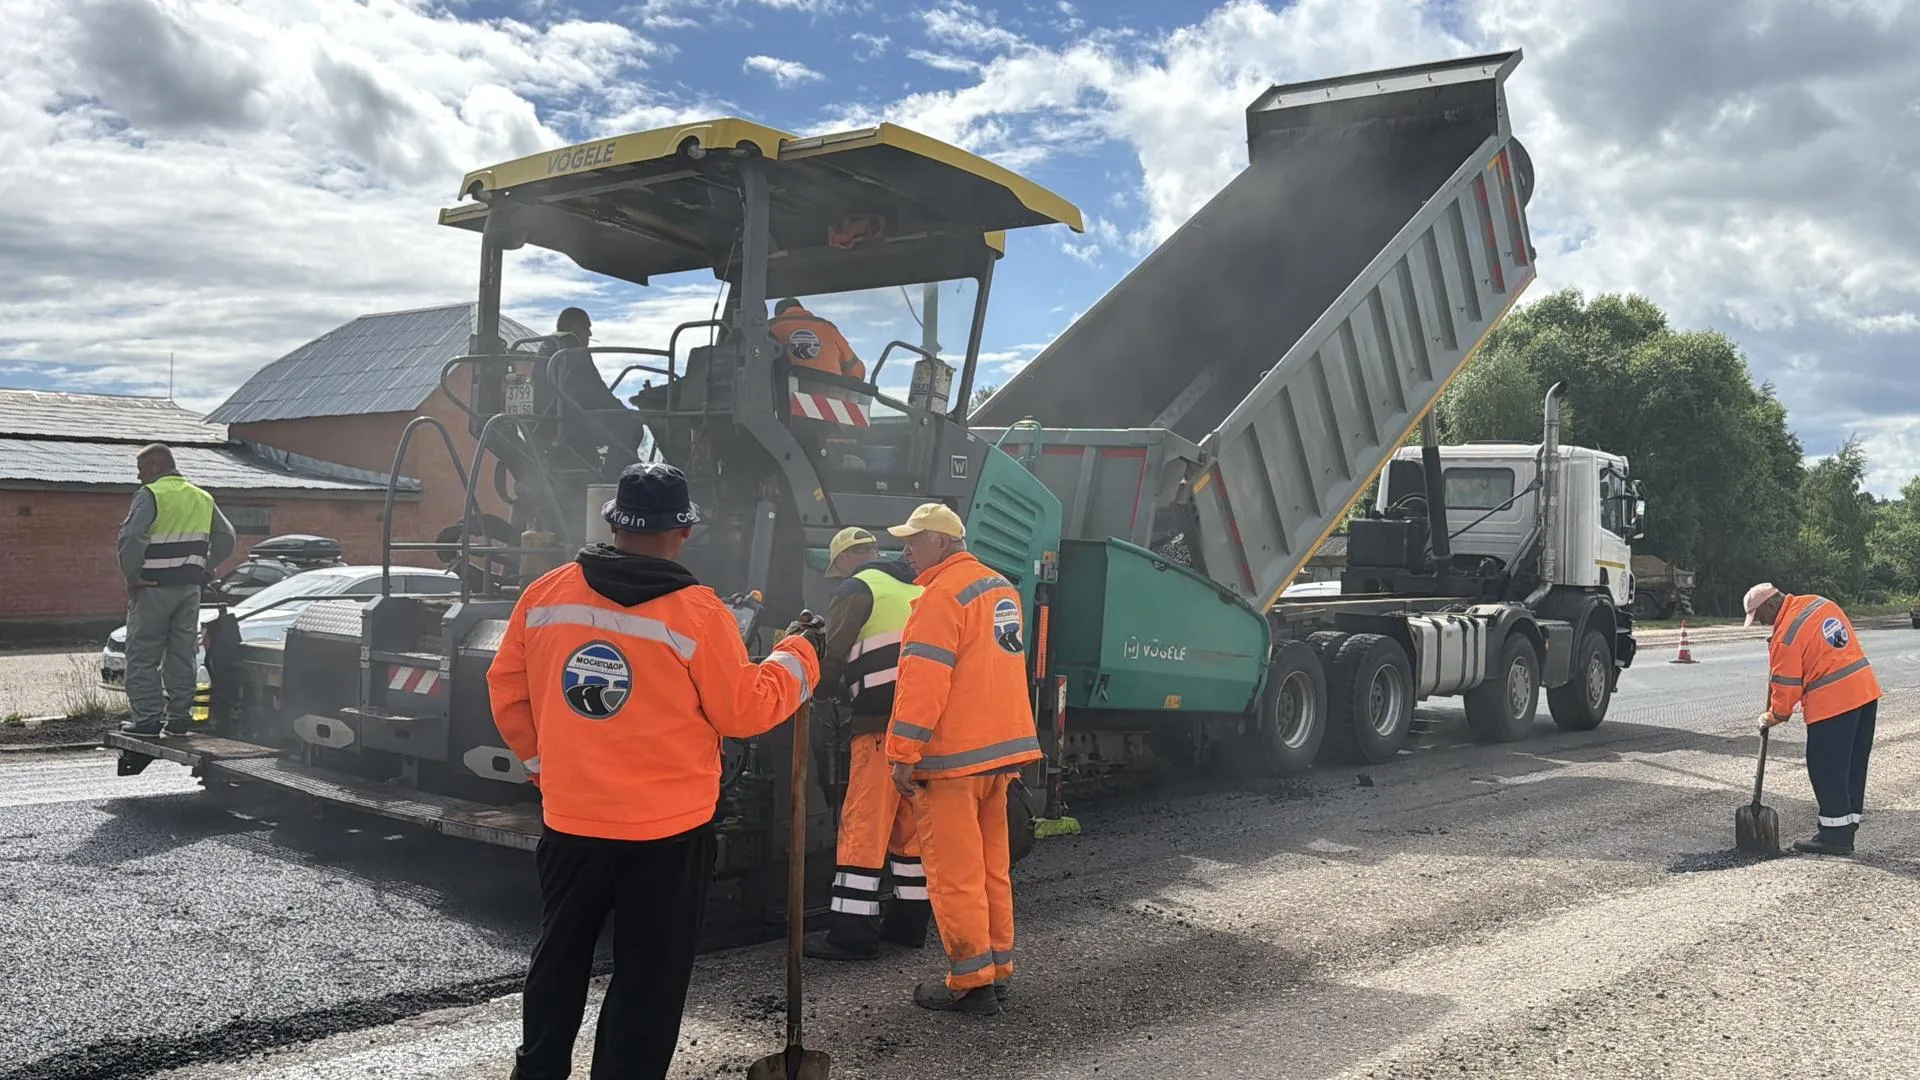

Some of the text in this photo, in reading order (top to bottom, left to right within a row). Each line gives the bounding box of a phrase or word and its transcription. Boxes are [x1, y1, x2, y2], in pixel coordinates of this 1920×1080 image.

[547, 142, 616, 174] VÖGELE
[508, 386, 531, 400] 3799
[610, 508, 646, 528] Klein
[576, 656, 624, 671] МОСАВТОДОР
